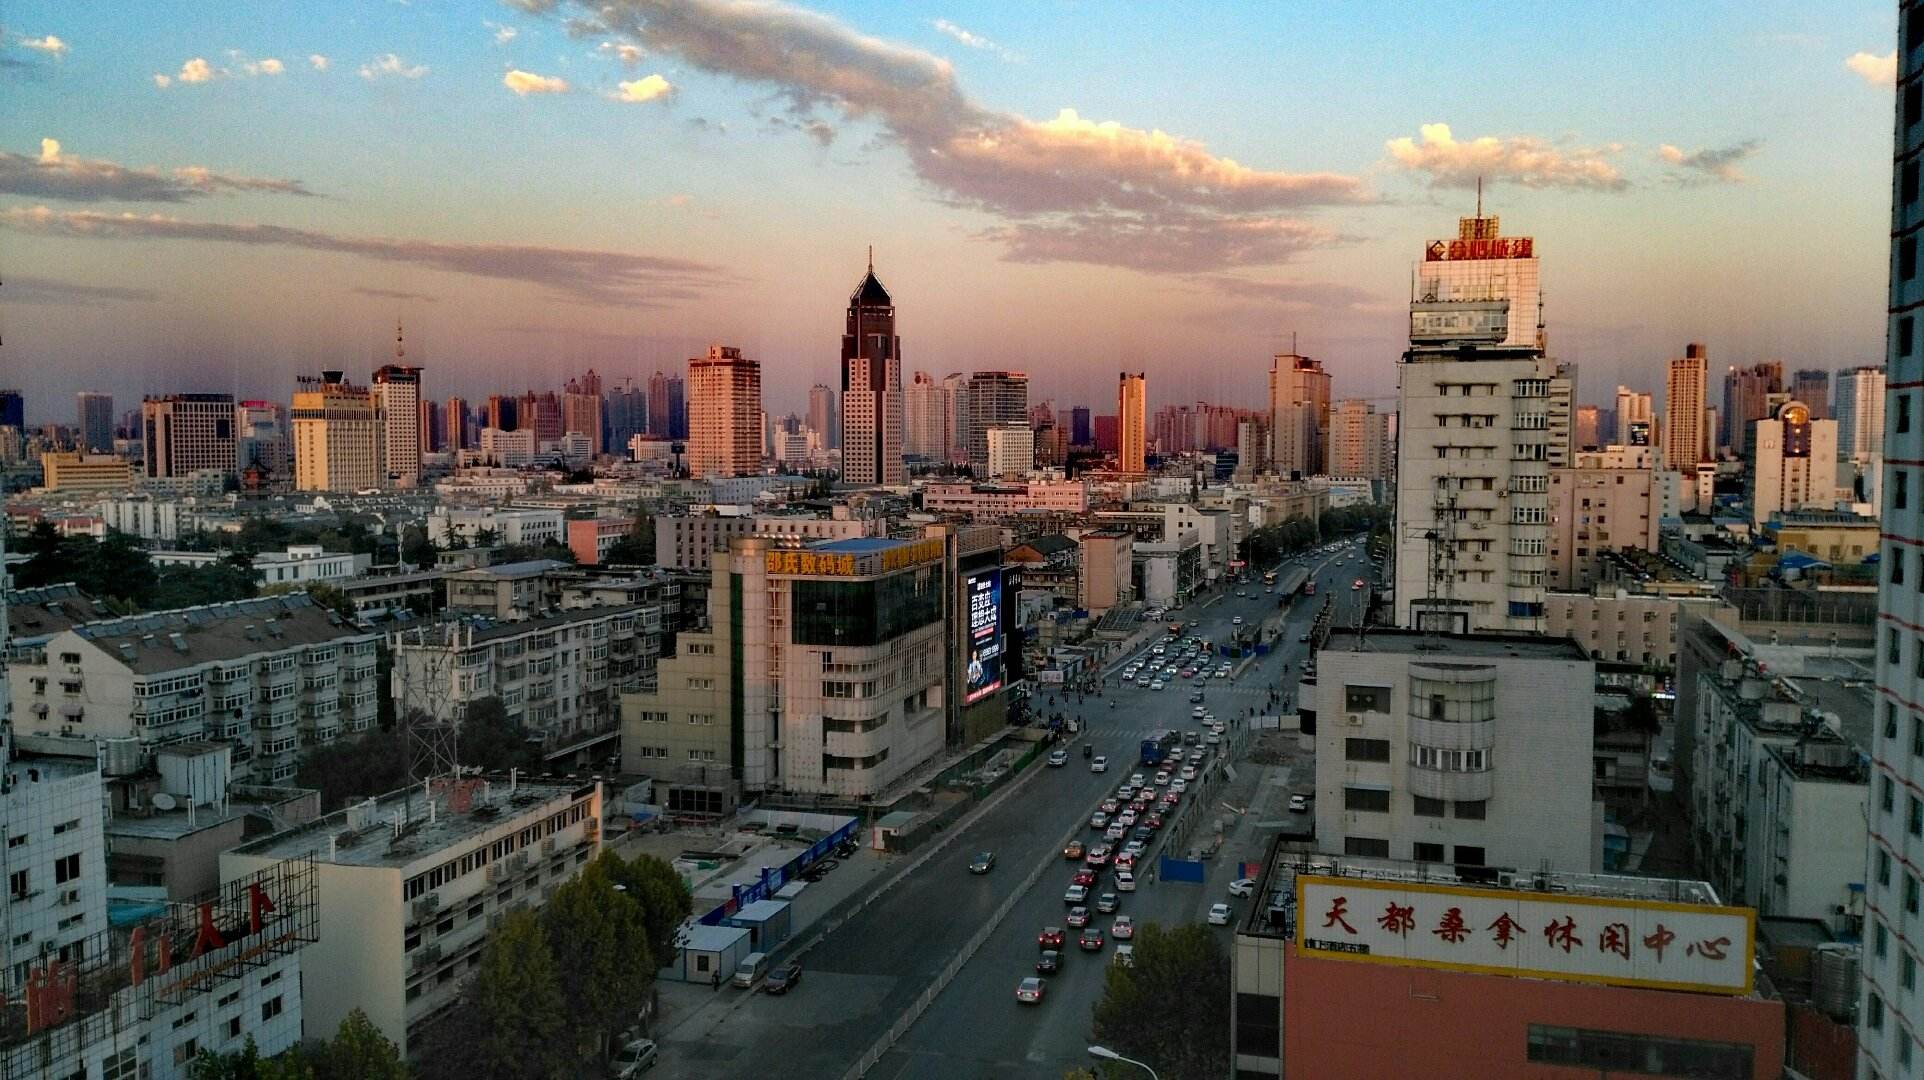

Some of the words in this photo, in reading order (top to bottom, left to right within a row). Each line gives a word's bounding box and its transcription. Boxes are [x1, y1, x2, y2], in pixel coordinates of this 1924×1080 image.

[1320, 896, 1732, 963] 天都桑拿休闲中心
